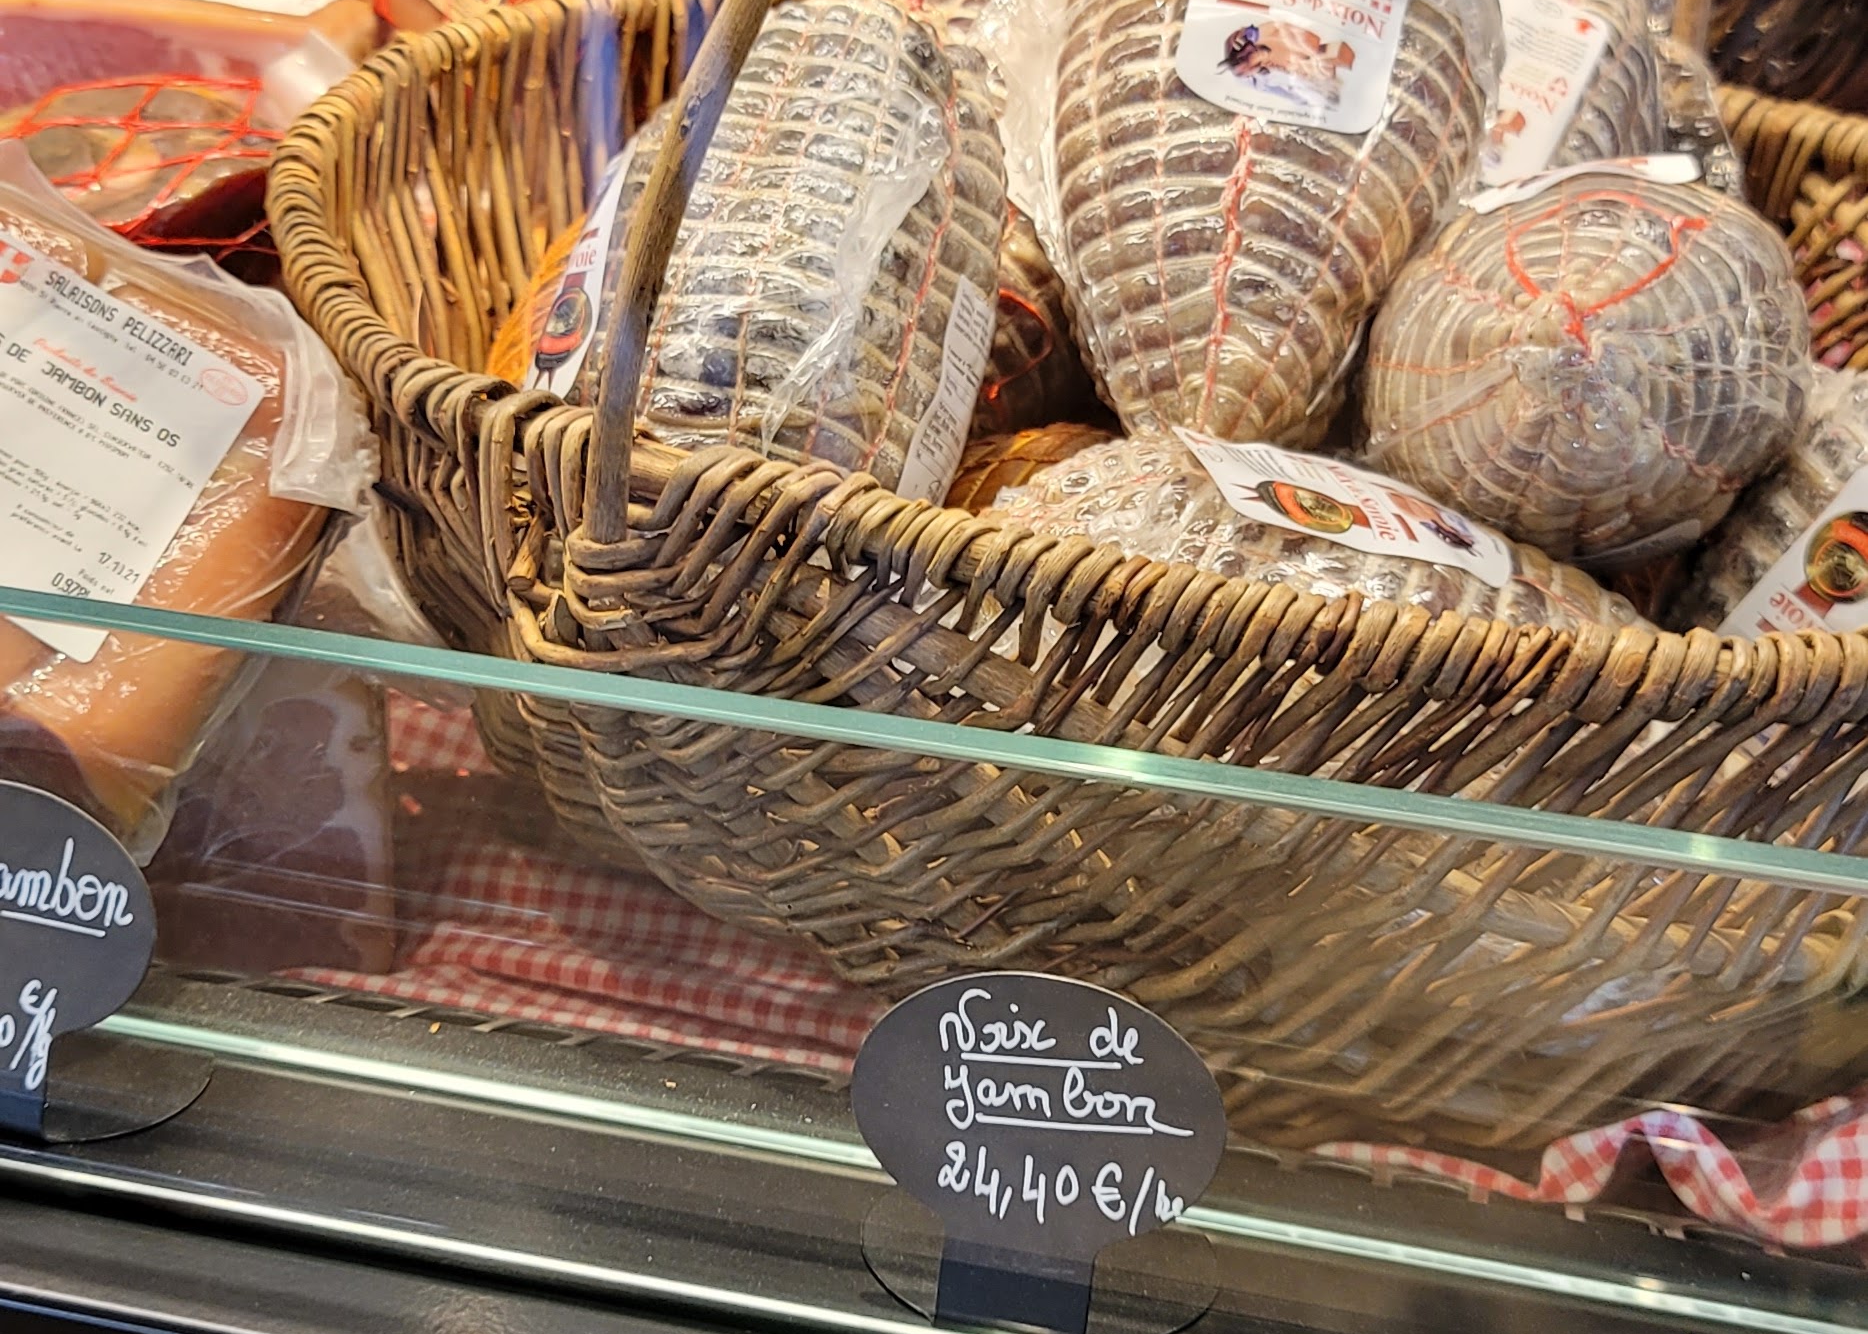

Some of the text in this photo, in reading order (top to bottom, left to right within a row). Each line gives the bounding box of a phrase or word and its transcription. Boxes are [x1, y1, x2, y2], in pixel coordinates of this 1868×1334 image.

[1330, 5, 1388, 39] Noix
[44, 271, 195, 367] SALAISONS PELIZZARI
[6, 342, 33, 364] DE
[40, 360, 108, 408] JAMBON
[109, 402, 154, 434] SANS
[156, 428, 182, 448] OS
[939, 988, 1144, 1065] Noix de
